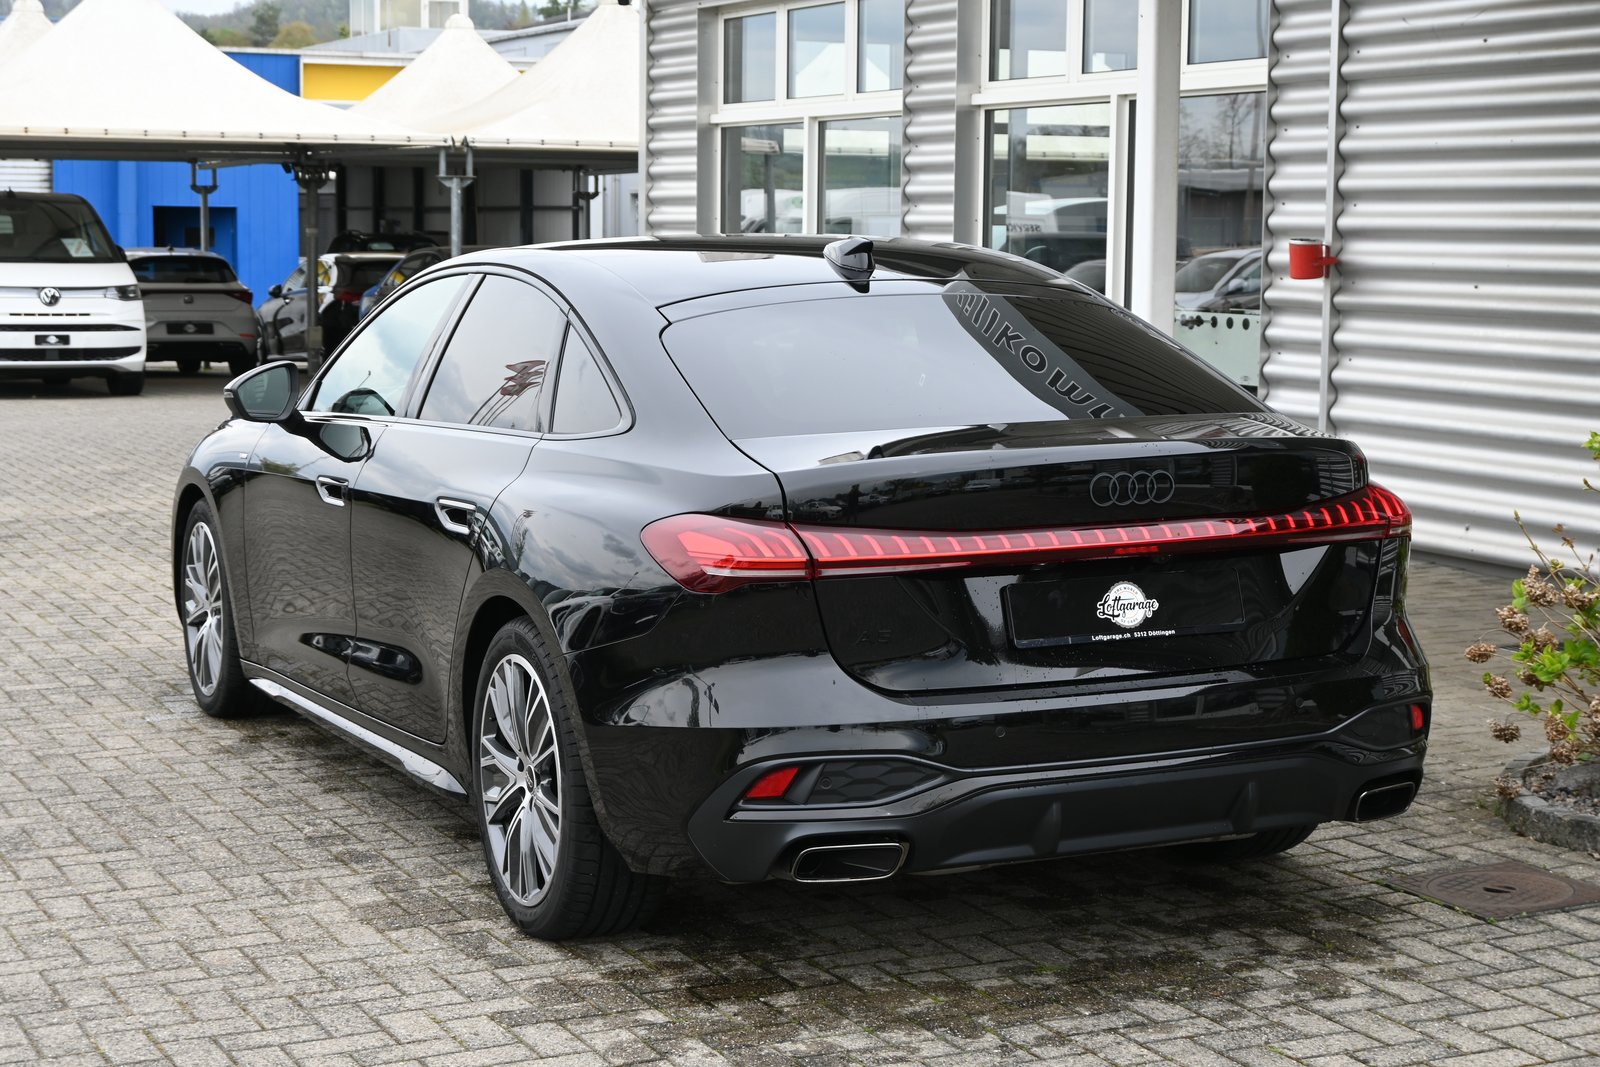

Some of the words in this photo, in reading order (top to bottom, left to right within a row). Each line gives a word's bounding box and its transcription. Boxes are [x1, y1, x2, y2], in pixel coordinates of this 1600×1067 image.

[1098, 594, 1158, 620] Loftgarage
[1091, 632, 1131, 641] Loftgarage.ch
[1148, 629, 1176, 637] Döttingen
